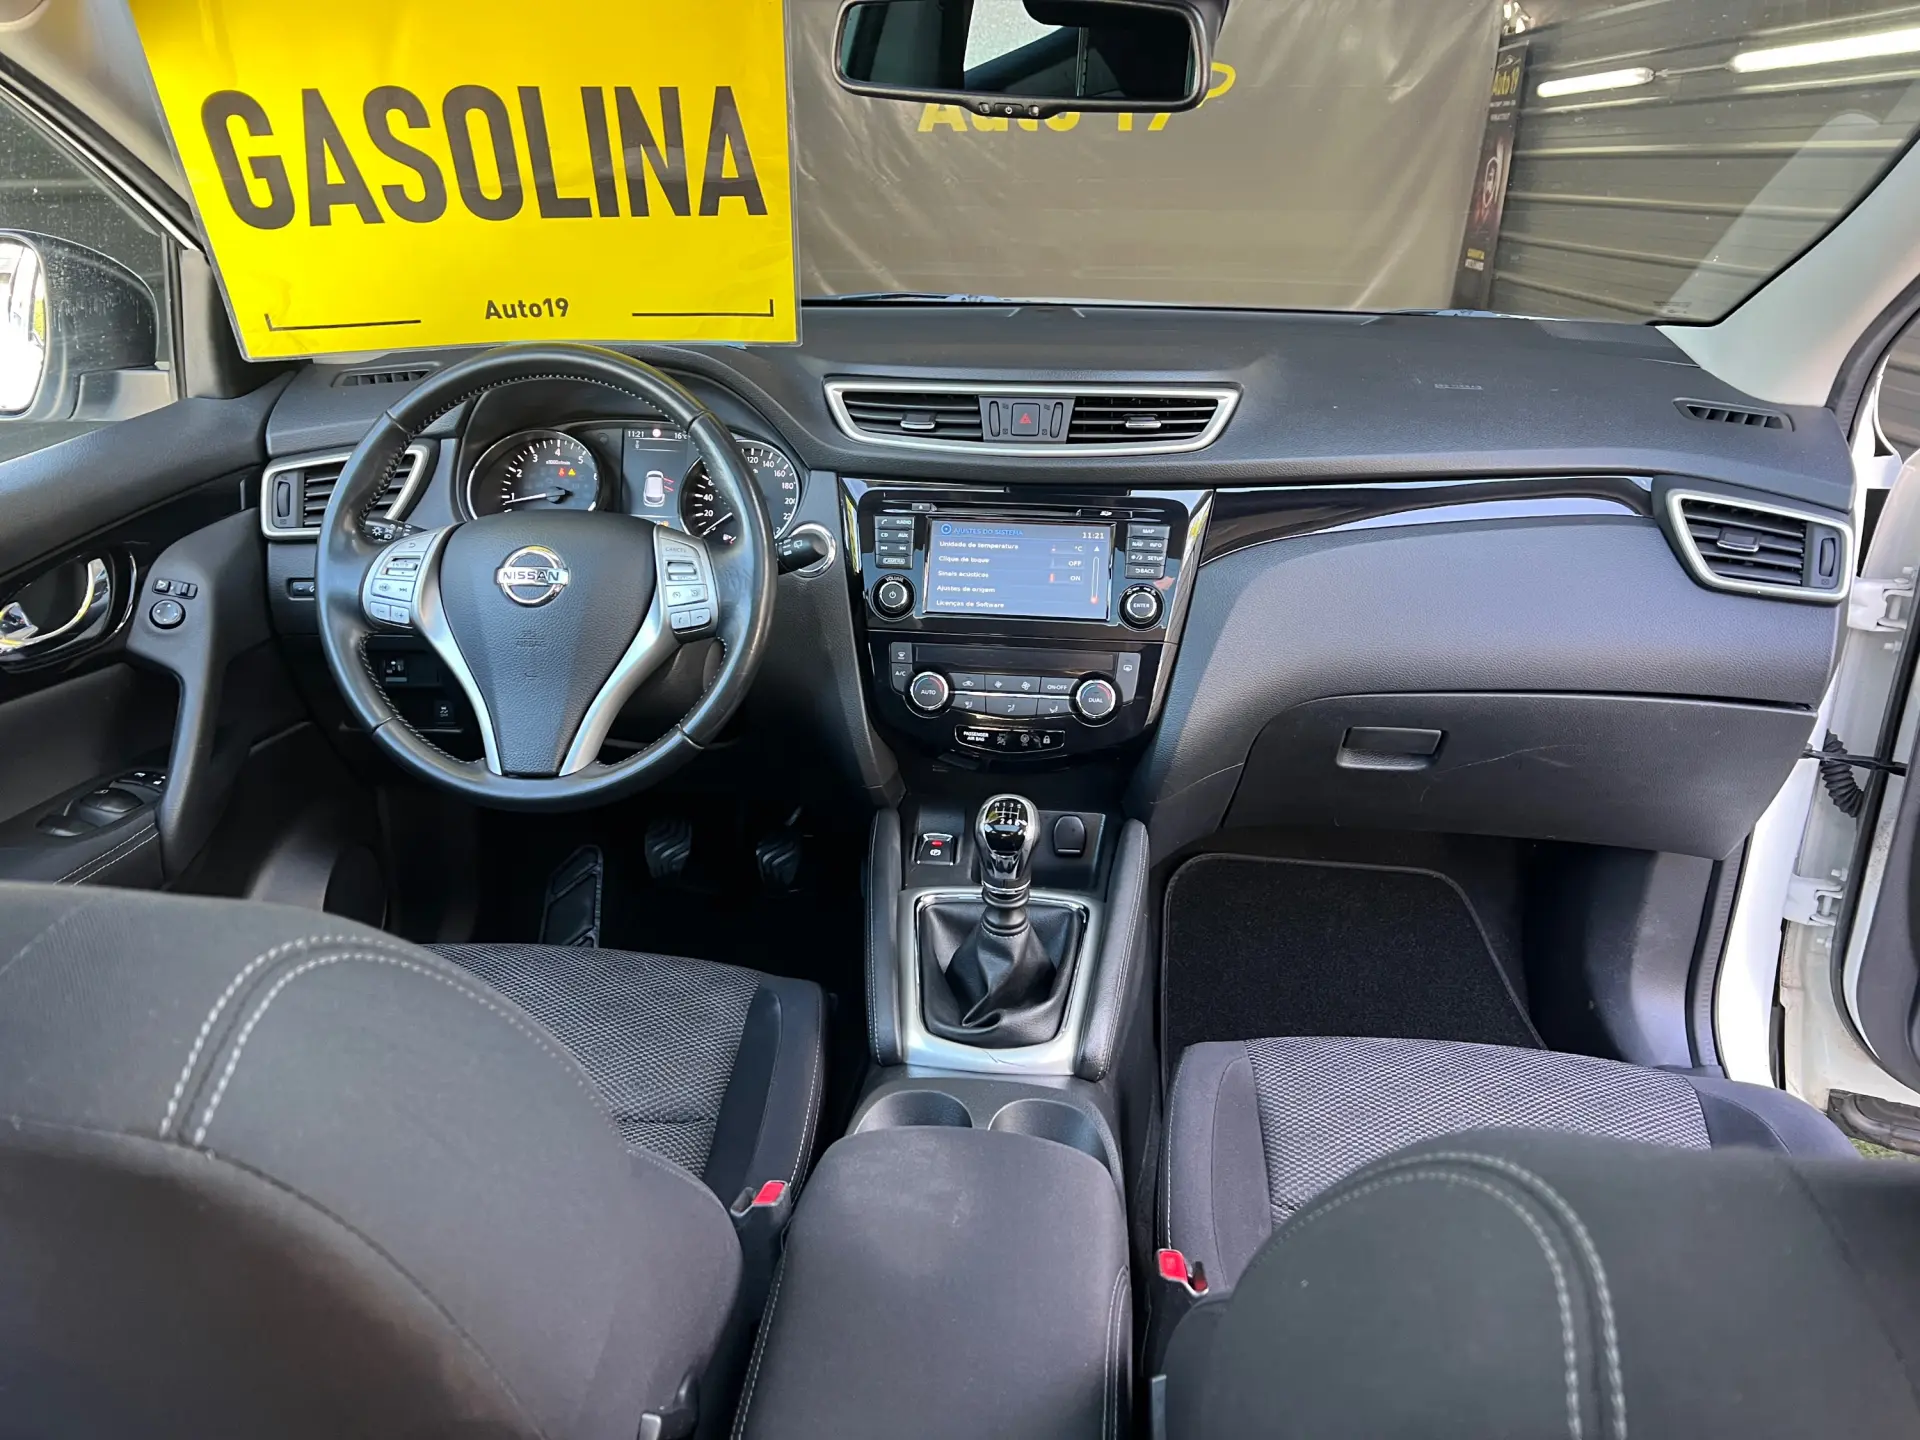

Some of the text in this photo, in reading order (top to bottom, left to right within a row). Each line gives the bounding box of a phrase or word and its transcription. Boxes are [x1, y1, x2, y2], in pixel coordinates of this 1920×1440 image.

[200, 84, 768, 230] GASOLINA
[485, 297, 569, 320] Auto19
[554, 447, 561, 456] 4
[532, 453, 539, 463] 3
[577, 455, 584, 464] 5
[762, 460, 775, 468] 140
[516, 468, 523, 478] 2
[773, 469, 786, 478] 160
[781, 482, 794, 490] 180
[703, 493, 714, 502] 40
[703, 508, 714, 517] 20
[953, 527, 982, 536] AJUSTES
[1082, 531, 1105, 540] 11:21
[939, 541, 967, 549] Unidade
[938, 555, 960, 563] Clique
[970, 556, 991, 564] toque
[502, 570, 560, 582] NISSAN
[937, 570, 990, 579] Sinais acústicos
[936, 585, 961, 593] Ajustes
[971, 587, 996, 595] origem
[936, 599, 965, 608] Licenças
[975, 601, 1005, 609] Software
[963, 730, 989, 738] PASSENGER
